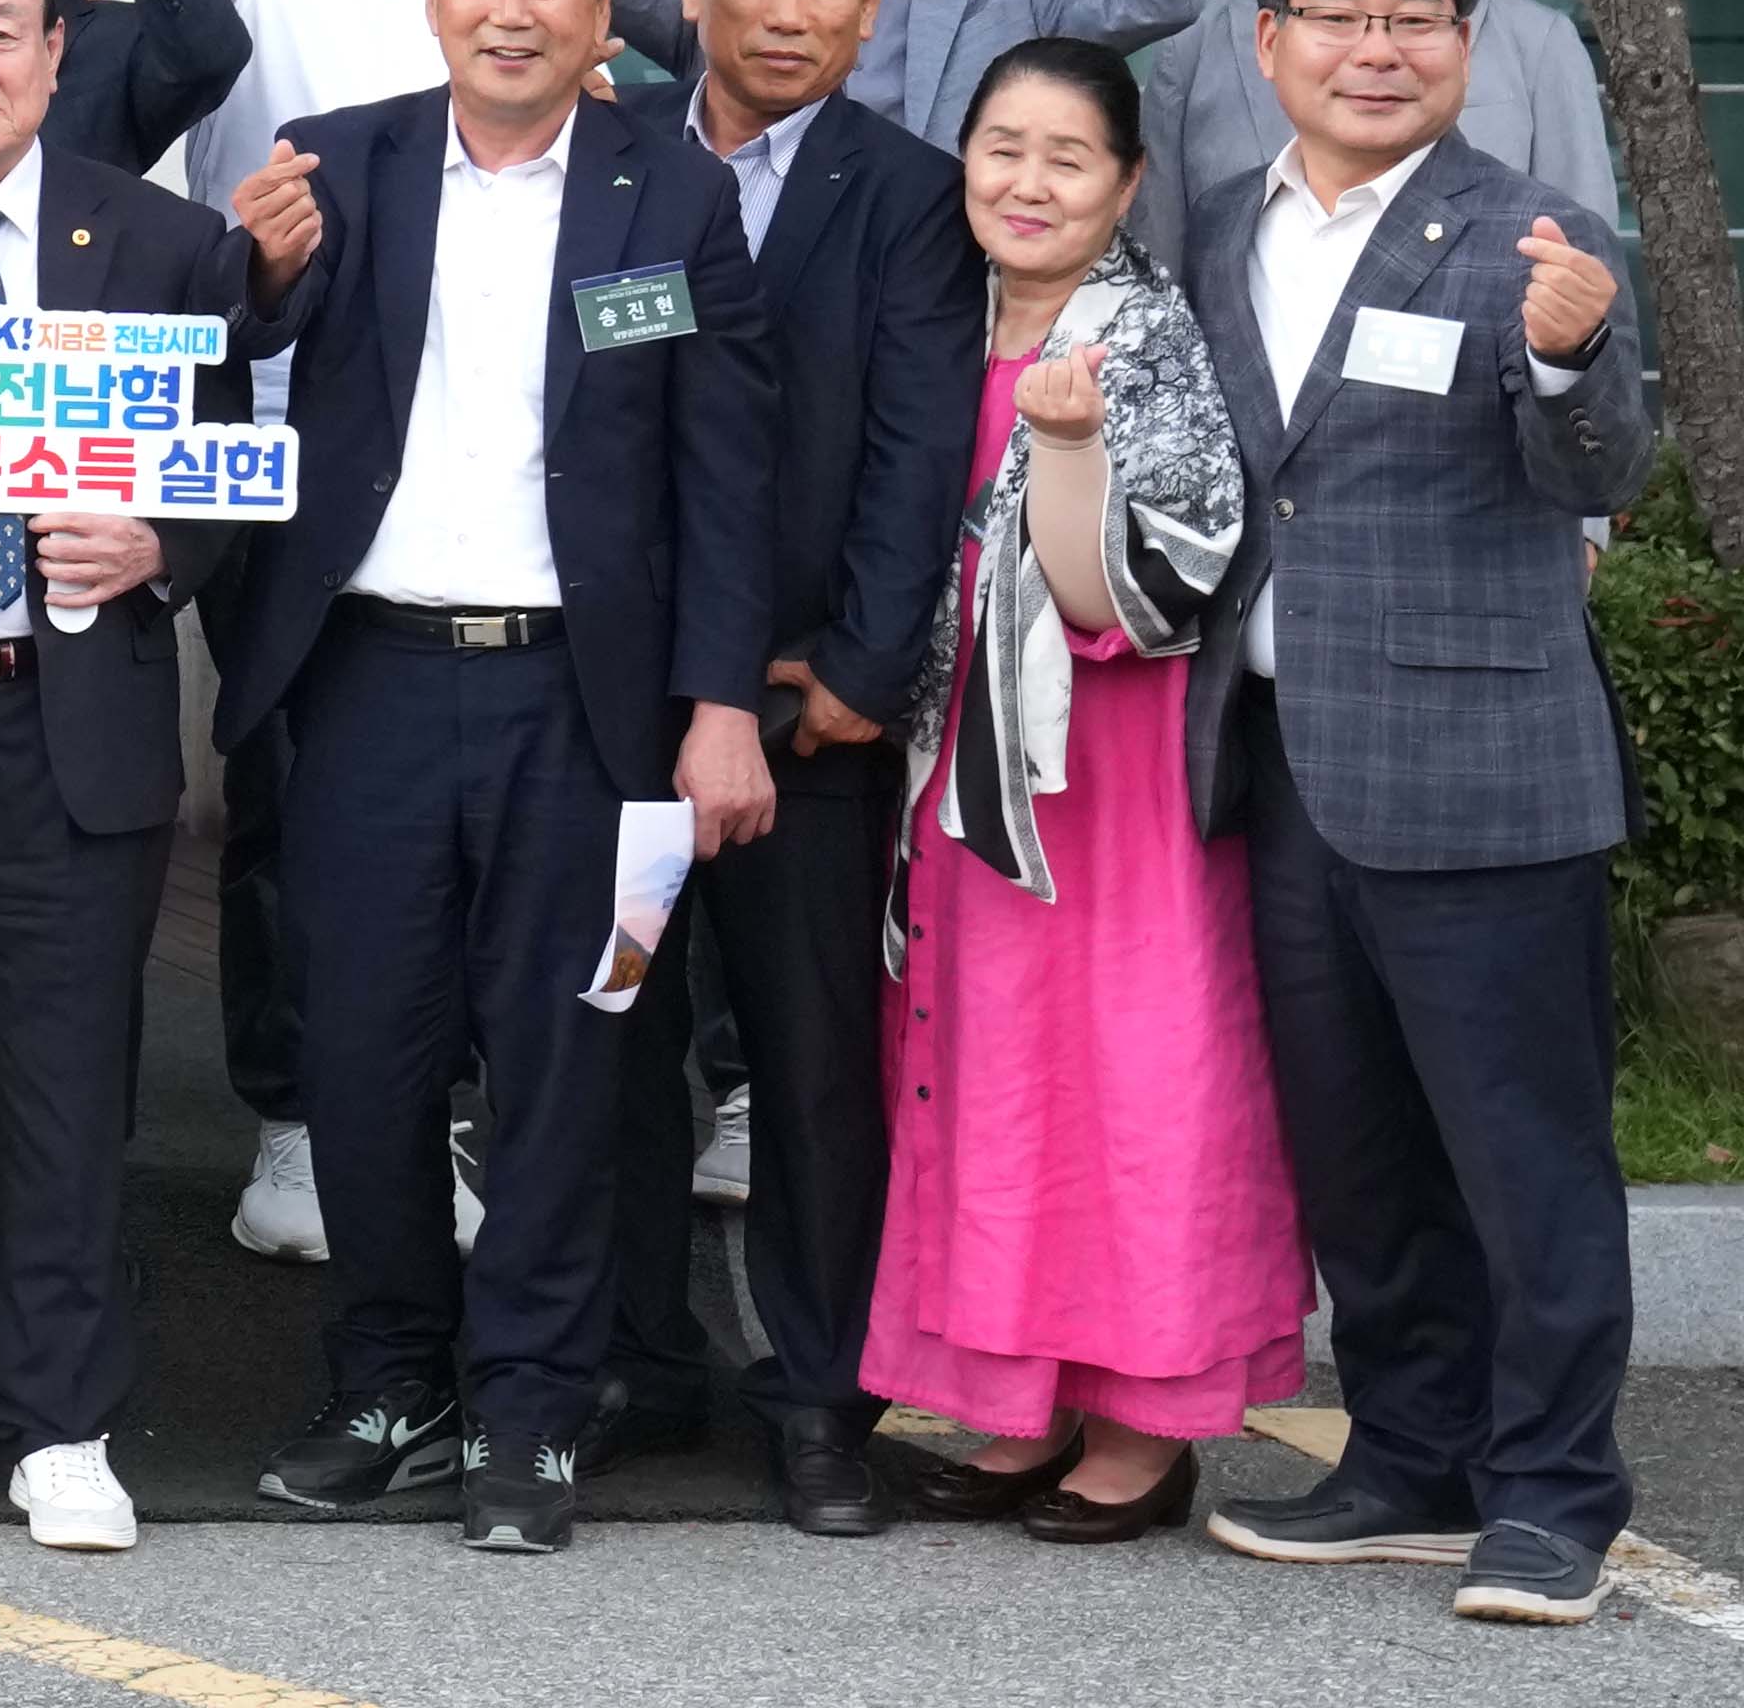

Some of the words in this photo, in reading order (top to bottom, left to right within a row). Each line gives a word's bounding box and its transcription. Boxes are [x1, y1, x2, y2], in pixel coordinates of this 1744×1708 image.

[37, 322, 109, 353] 지금은
[113, 324, 219, 356] 전남시대
[159, 439, 286, 507] 실현
